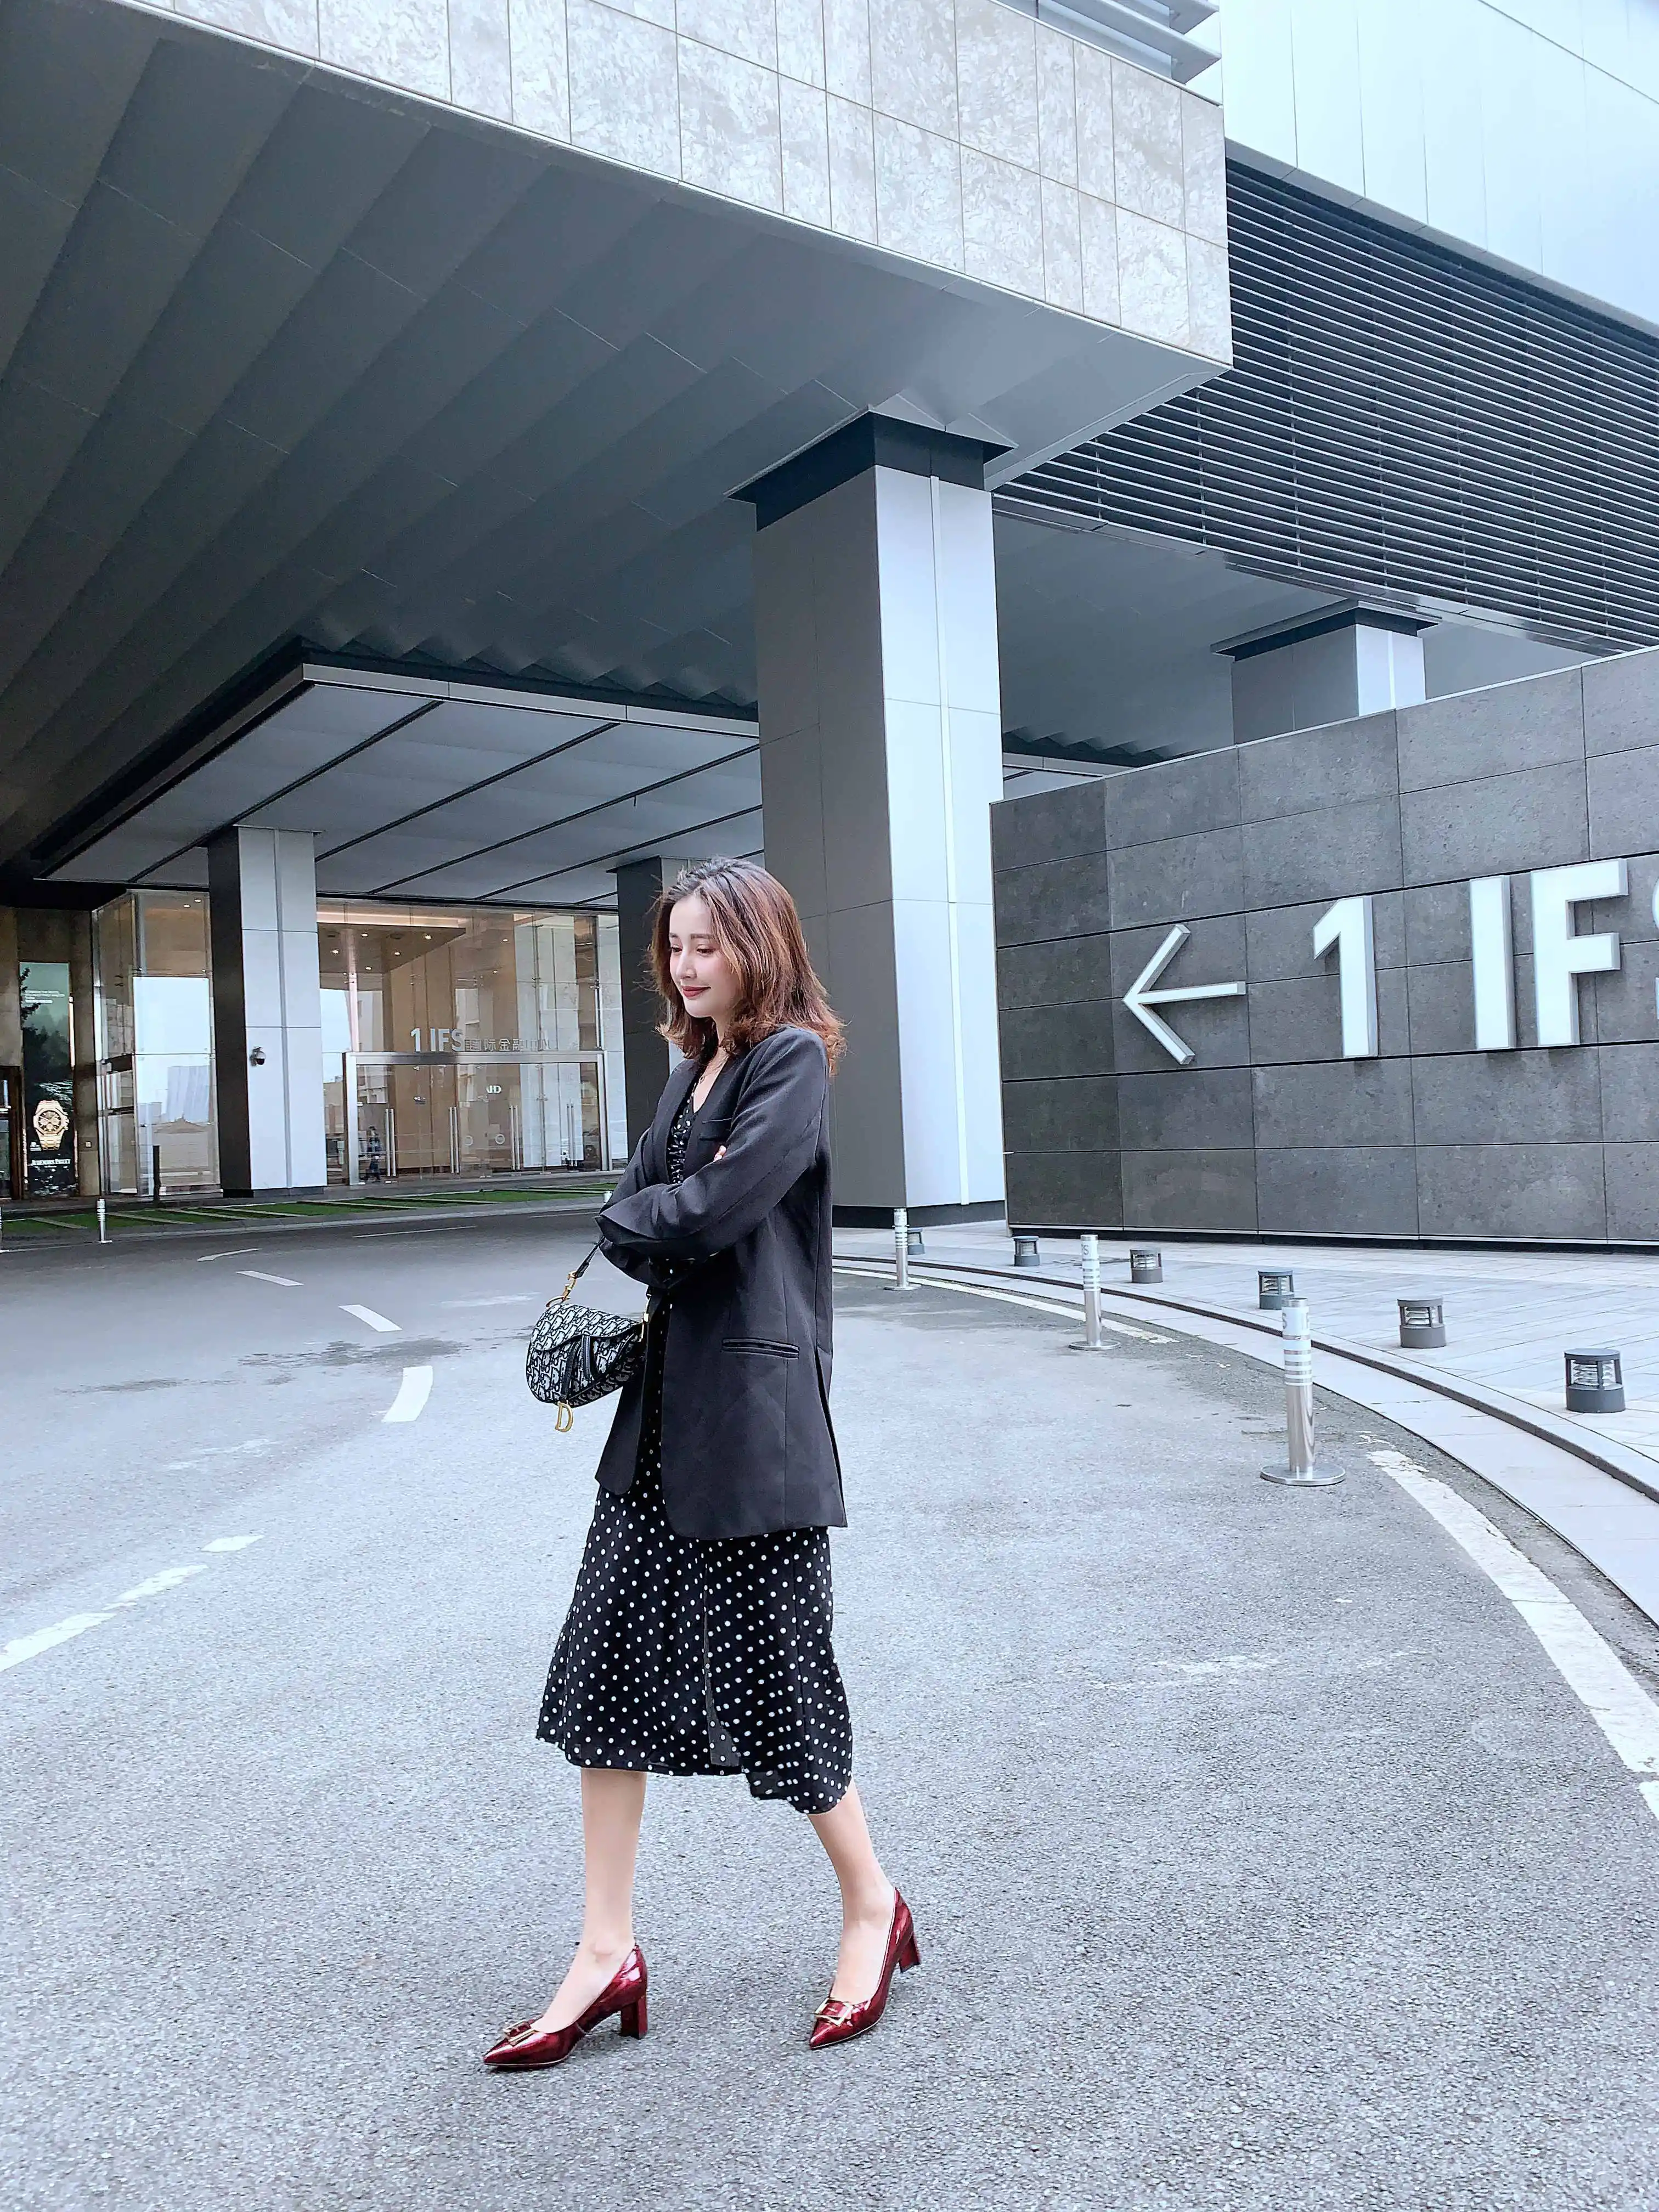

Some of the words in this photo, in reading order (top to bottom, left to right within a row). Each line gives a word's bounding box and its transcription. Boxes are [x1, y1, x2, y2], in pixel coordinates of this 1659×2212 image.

[1313, 895, 1378, 1057] 1
[1470, 858, 1659, 1049] IF
[411, 1028, 421, 1052] 1
[430, 1028, 465, 1052] IFS
